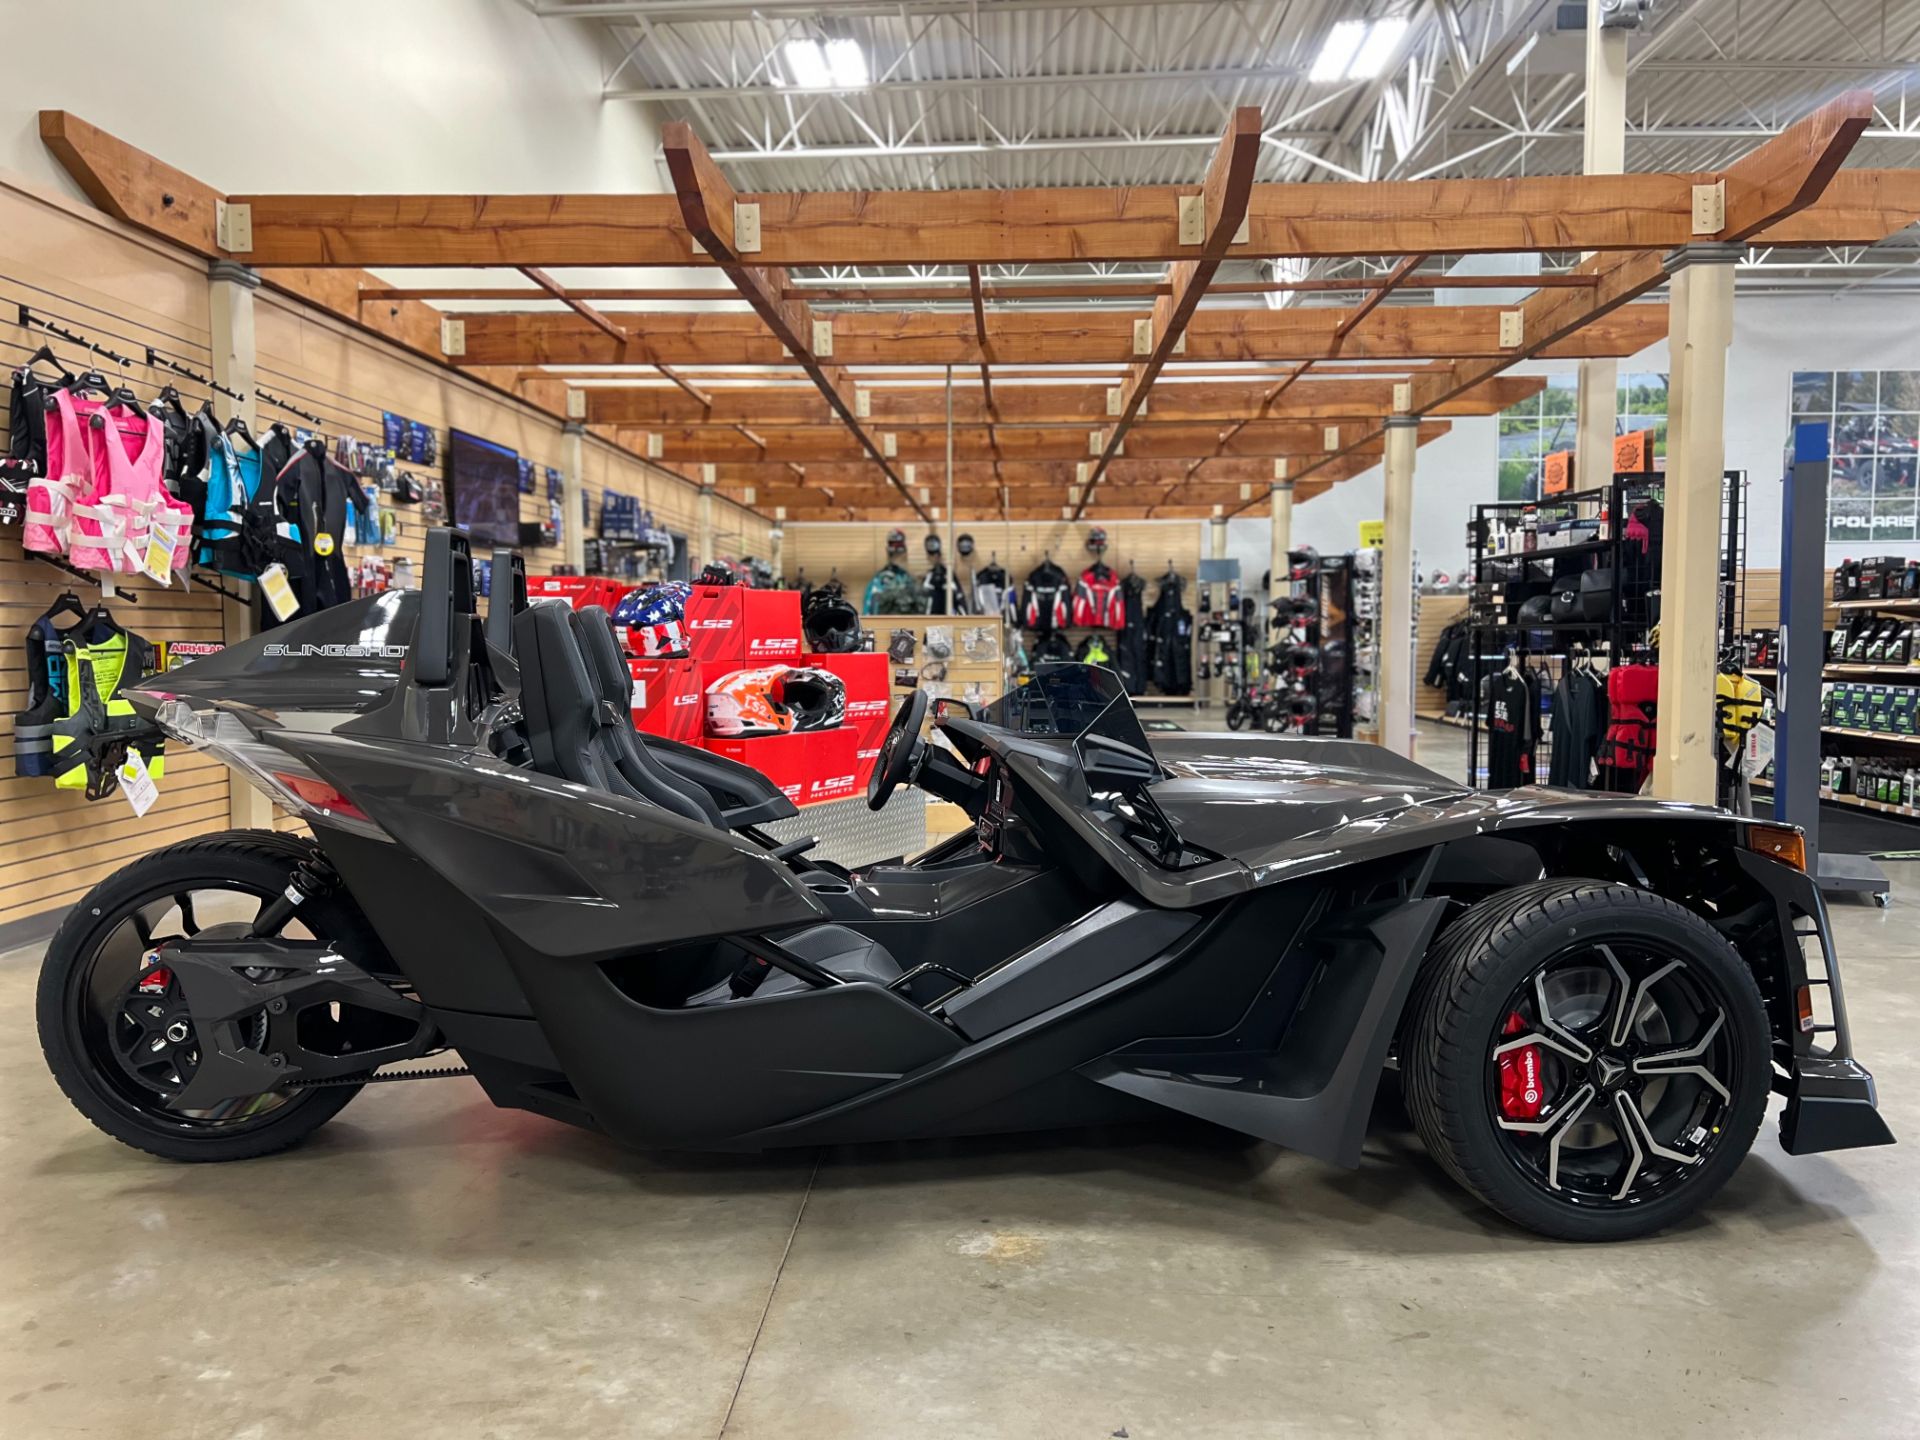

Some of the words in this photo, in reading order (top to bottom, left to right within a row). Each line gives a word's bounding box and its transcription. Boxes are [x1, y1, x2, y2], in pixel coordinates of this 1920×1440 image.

[1832, 515, 1918, 528] POLARIS
[690, 619, 733, 629] LS2
[750, 638, 798, 649] LS2
[673, 694, 698, 706] LS2
[744, 694, 767, 716] LS2
[846, 700, 888, 711] S2
[857, 748, 881, 759] S2
[811, 775, 856, 791] LS2
[810, 786, 854, 799] HELMETS
[1525, 1051, 1535, 1089] brembo
